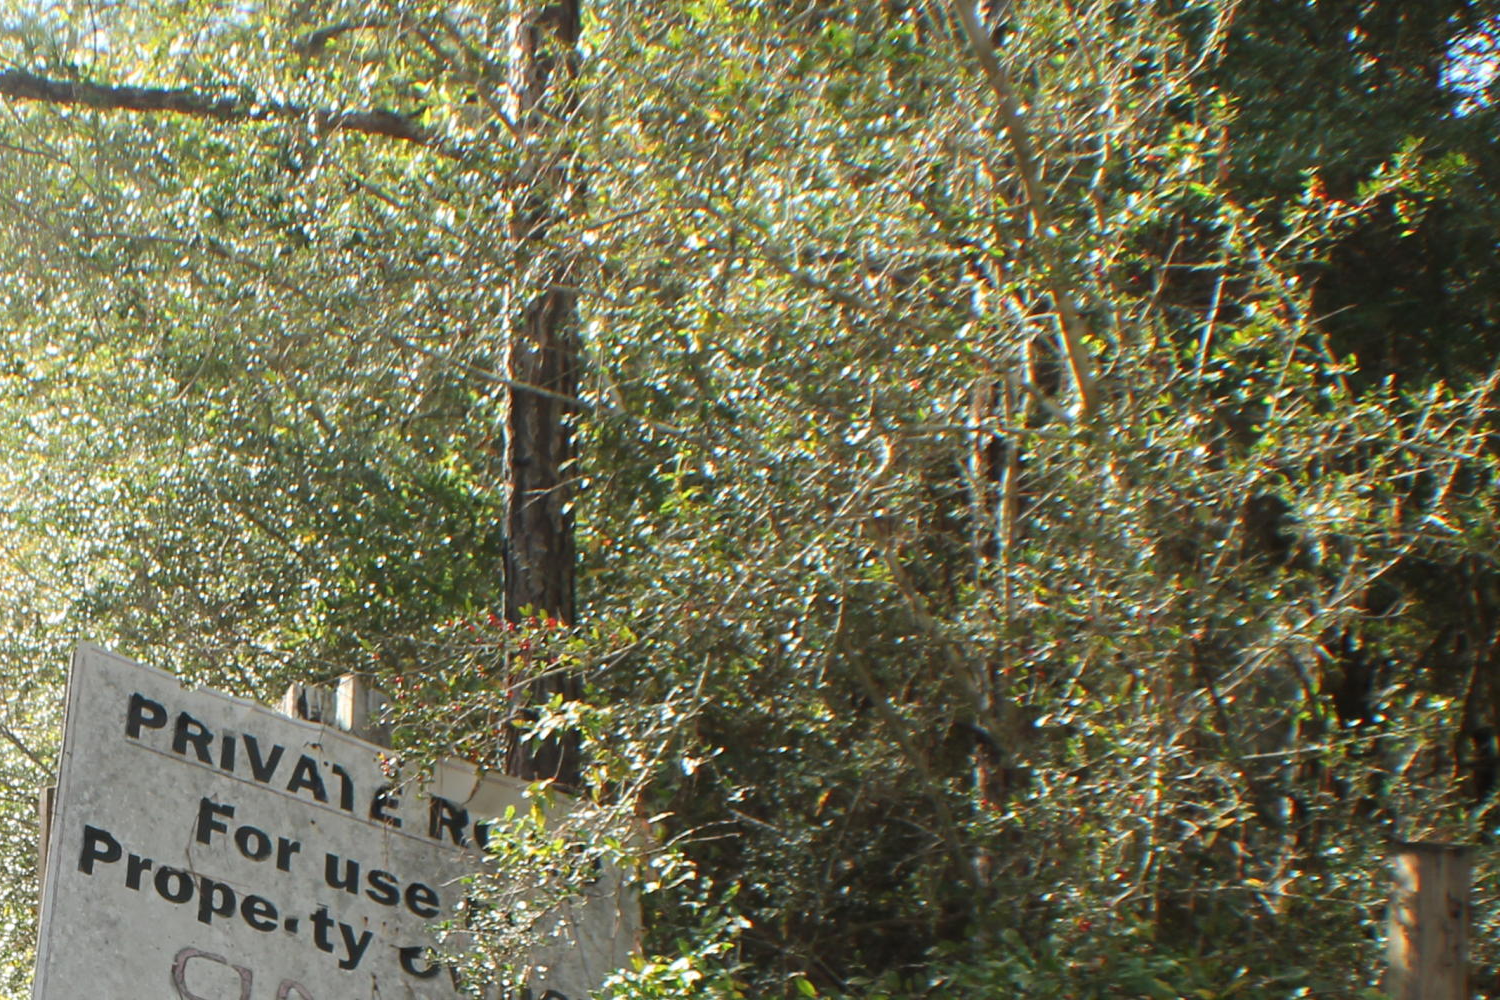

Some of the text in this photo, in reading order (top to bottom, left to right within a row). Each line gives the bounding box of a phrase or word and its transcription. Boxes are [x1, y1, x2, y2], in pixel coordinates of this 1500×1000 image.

[125, 692, 402, 828] PRIVATE
[196, 796, 301, 862] For
[324, 852, 441, 919] use
